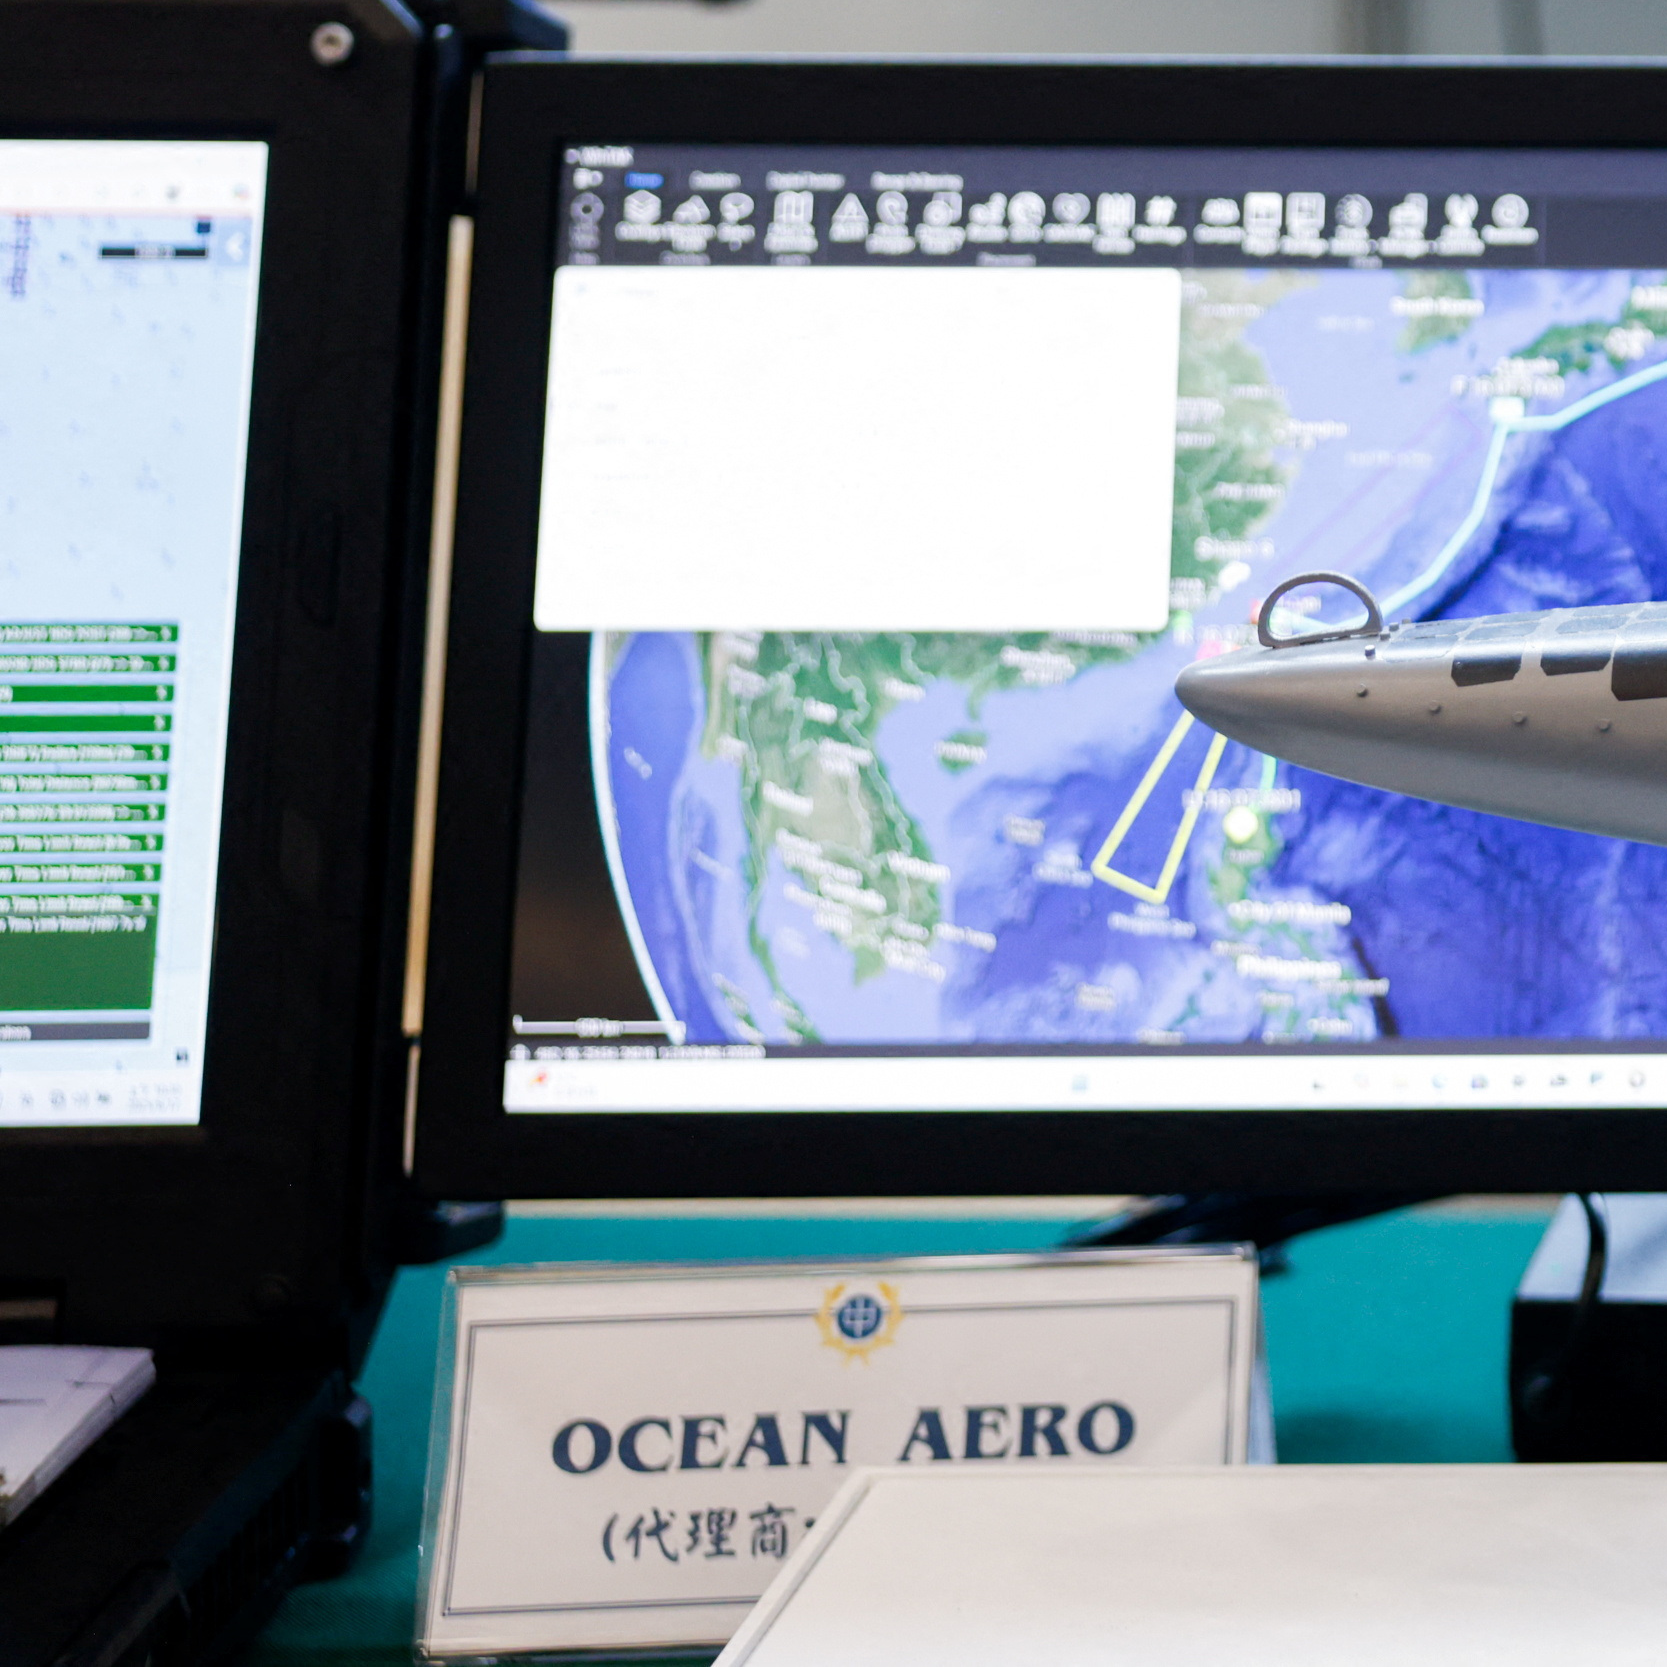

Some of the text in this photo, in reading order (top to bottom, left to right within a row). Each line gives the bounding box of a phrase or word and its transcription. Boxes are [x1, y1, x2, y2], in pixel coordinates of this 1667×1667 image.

[552, 1400, 1136, 1474] OCEAN AERO
[602, 1502, 816, 1565] (代理商
